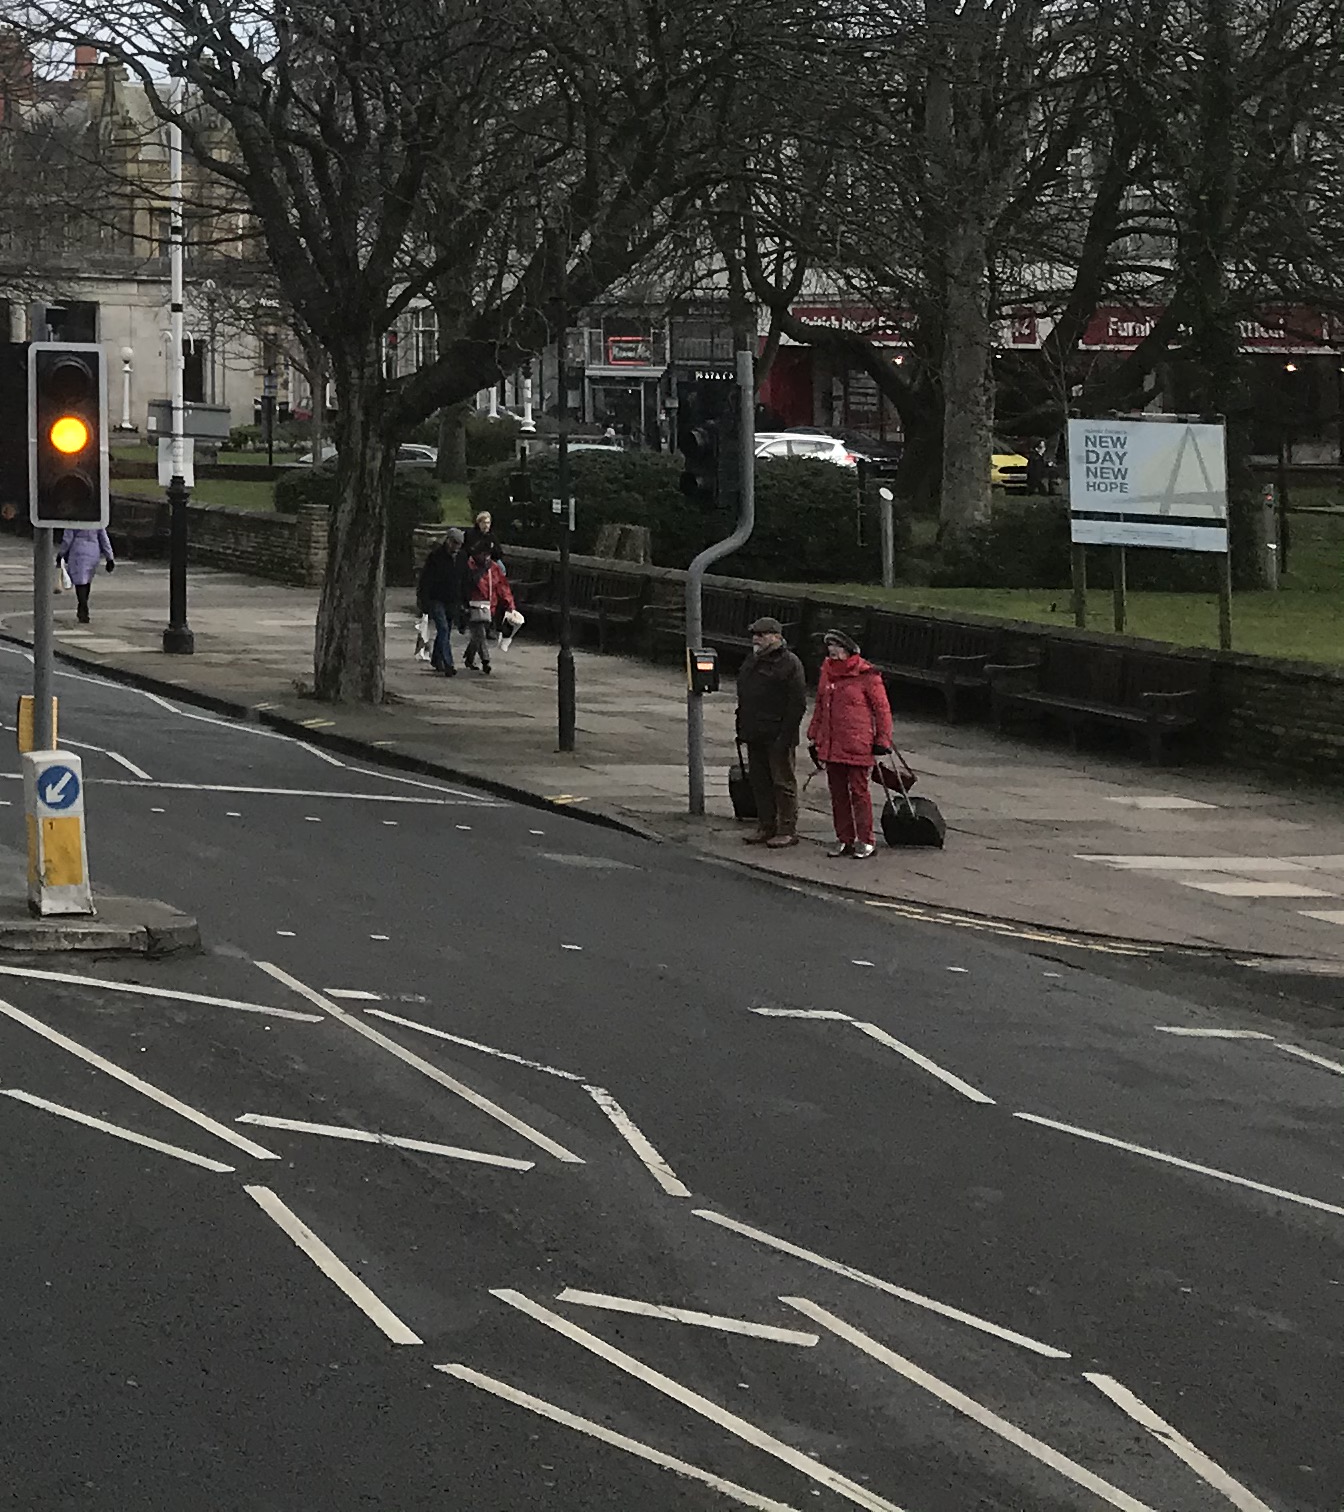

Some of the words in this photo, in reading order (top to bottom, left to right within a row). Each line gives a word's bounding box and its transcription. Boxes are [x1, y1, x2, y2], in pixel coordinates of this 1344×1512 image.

[1085, 435, 1128, 449] NEW
[1085, 449, 1129, 465] DAY
[1085, 465, 1129, 481] NEW
[1086, 481, 1129, 494] HOPE
